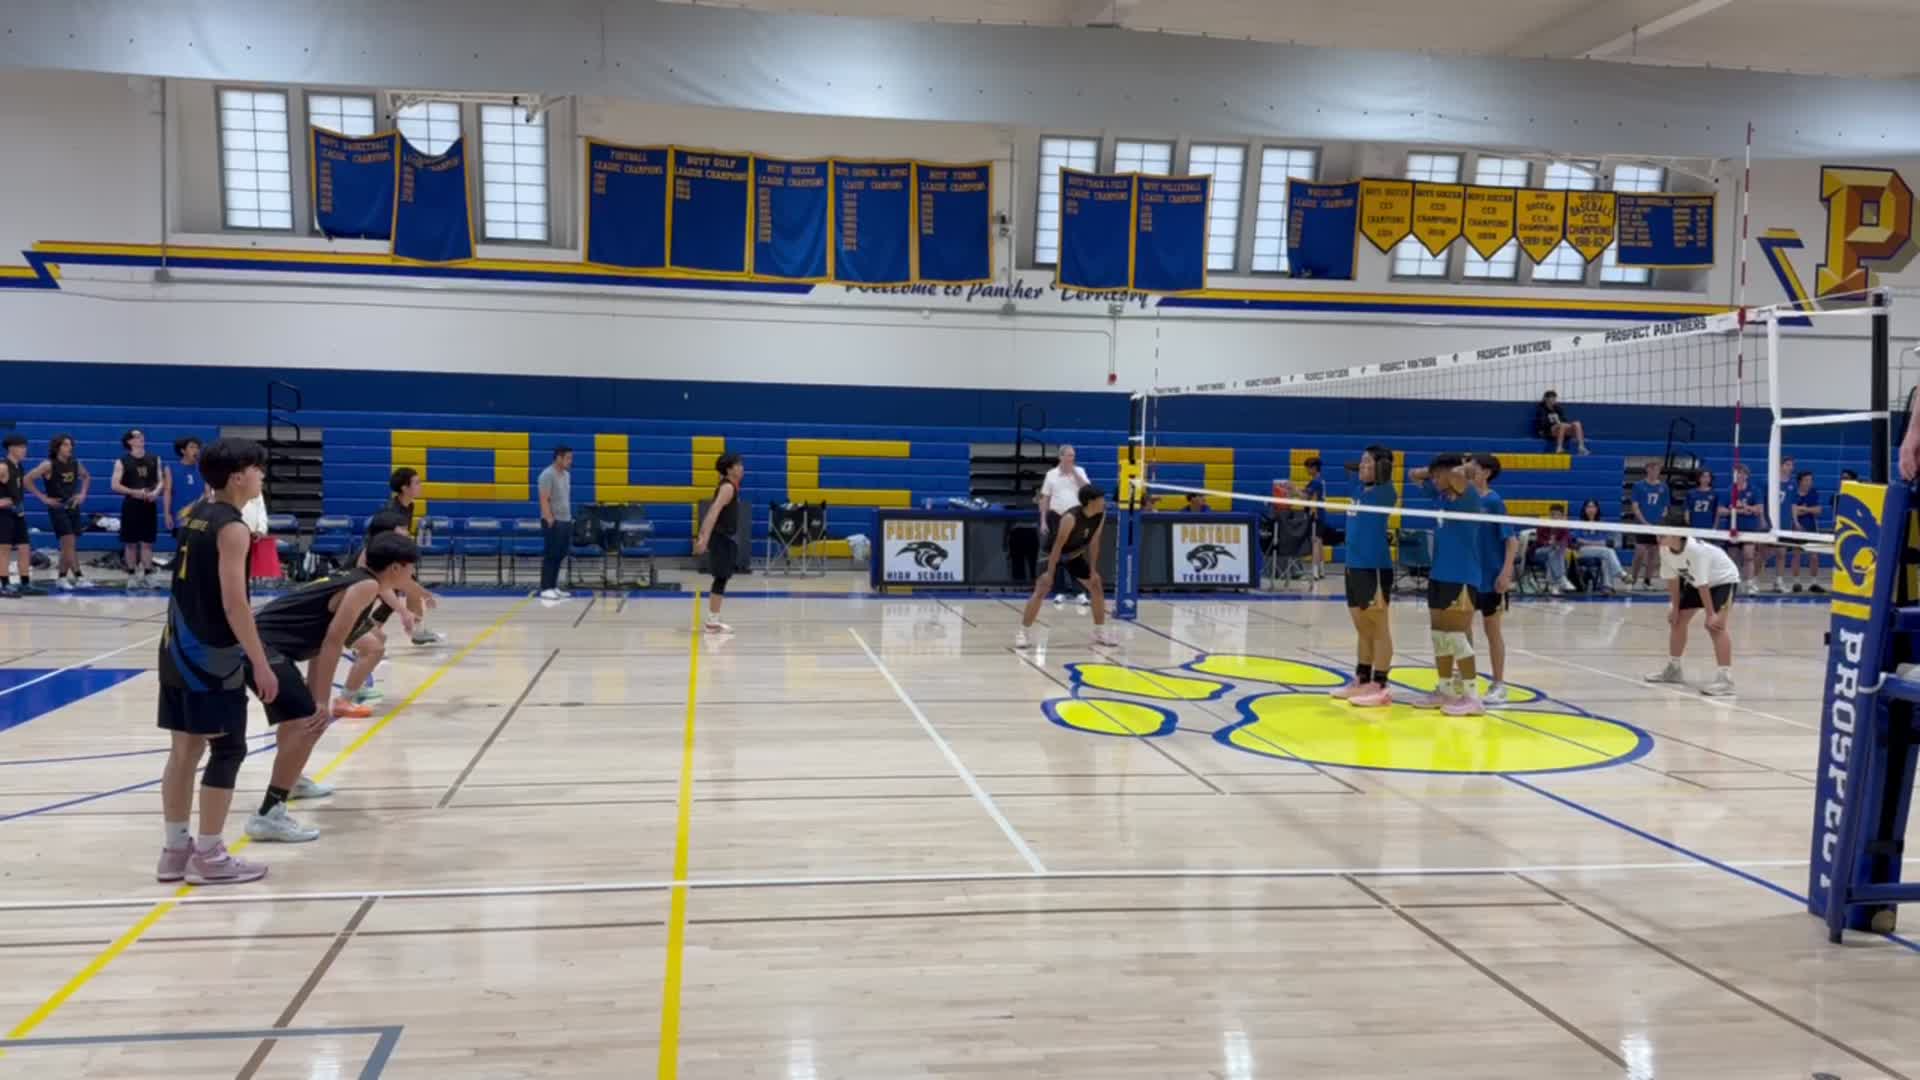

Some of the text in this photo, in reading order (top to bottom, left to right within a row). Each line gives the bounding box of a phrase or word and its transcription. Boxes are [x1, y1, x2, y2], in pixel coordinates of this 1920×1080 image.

[966, 277, 1044, 302] Panther
[1604, 316, 1708, 344] PROSPECT PANTHERS
[886, 522, 958, 541] PROSPECT
[918, 571, 955, 581] SCHOOL
[1182, 574, 1241, 583] TERRITORY
[1819, 627, 1865, 889] PROSPEC
